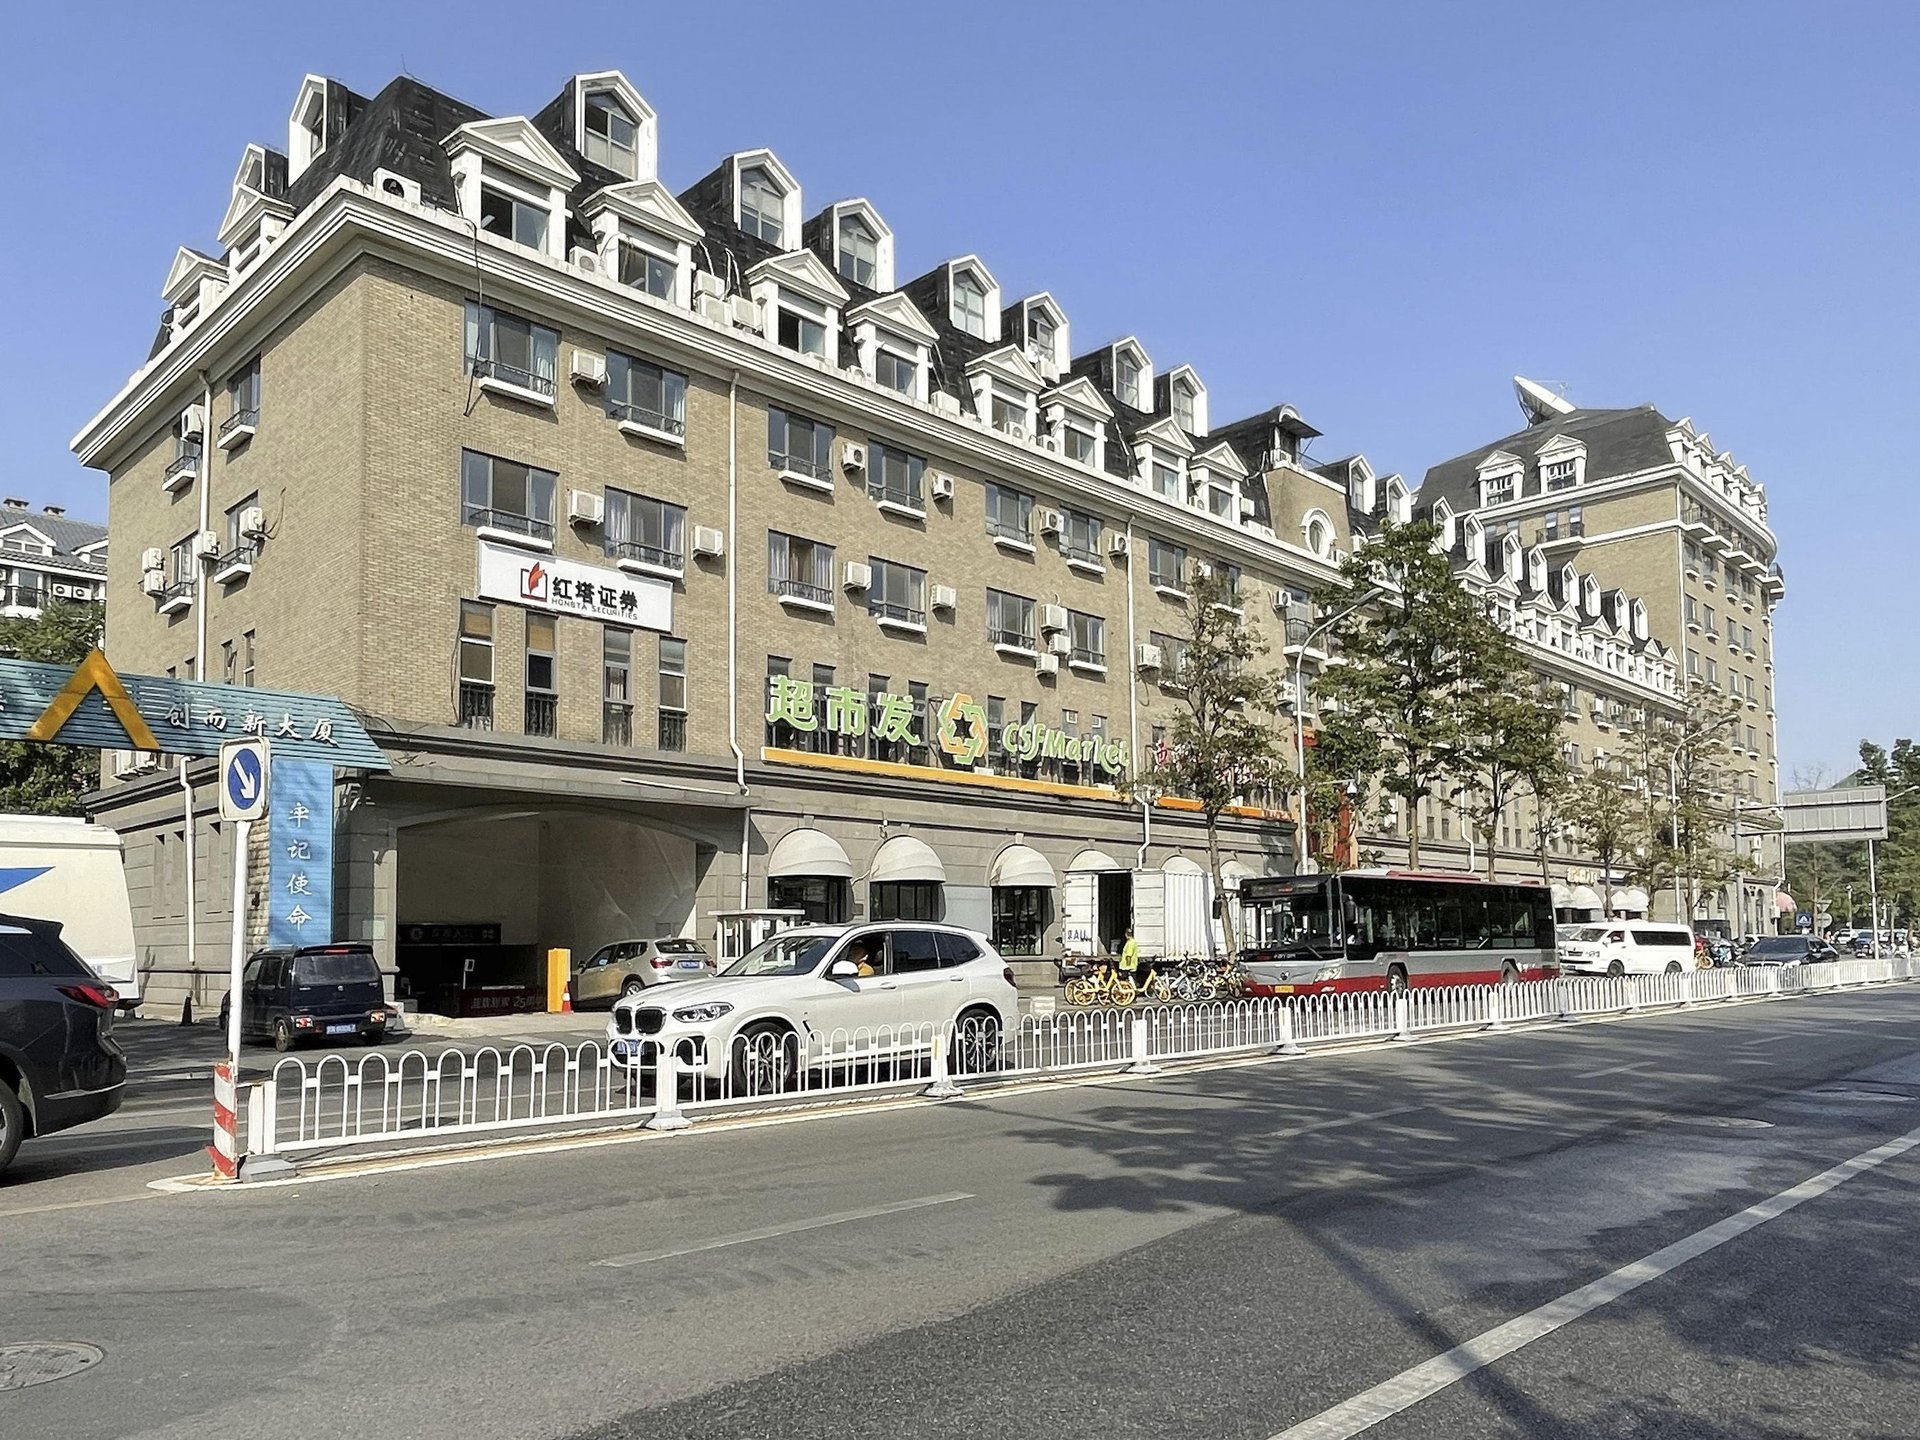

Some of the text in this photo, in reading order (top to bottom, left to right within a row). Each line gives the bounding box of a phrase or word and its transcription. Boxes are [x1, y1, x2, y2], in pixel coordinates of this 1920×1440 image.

[551, 598, 638, 621] HONGTA SECURITIES
[552, 576, 638, 612] 红塔证券
[165, 702, 340, 748] 创而新大厦
[765, 674, 921, 747] 超市发
